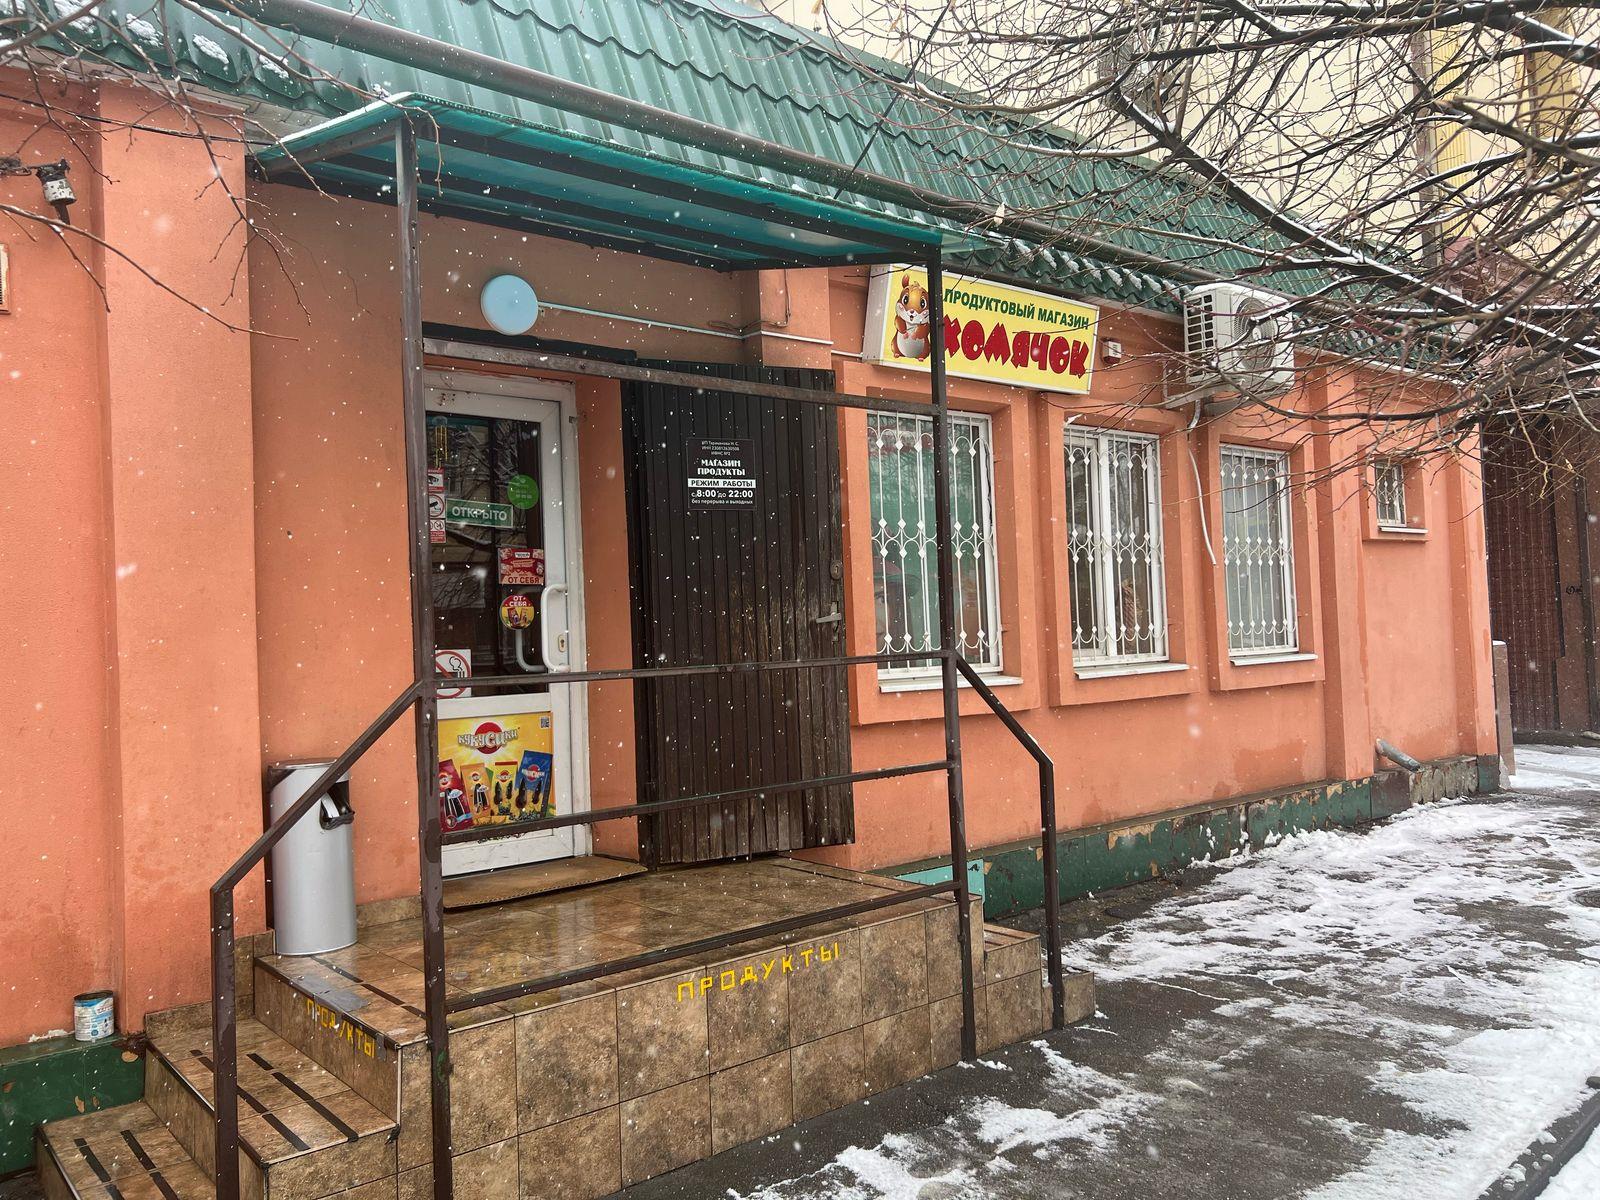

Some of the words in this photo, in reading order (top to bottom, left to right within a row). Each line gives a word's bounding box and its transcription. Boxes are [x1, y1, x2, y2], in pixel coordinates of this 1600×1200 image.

[944, 288, 1035, 320] ПРОДУКТОВЫЙ
[1037, 309, 1090, 330] МАГАЗИН
[701, 459, 741, 467] МАГАЗИН
[697, 468, 745, 476] ПРОДУКТЫ
[452, 506, 508, 521] ОТКРЫТО
[676, 941, 840, 1002] ПРОДУКТЫ
